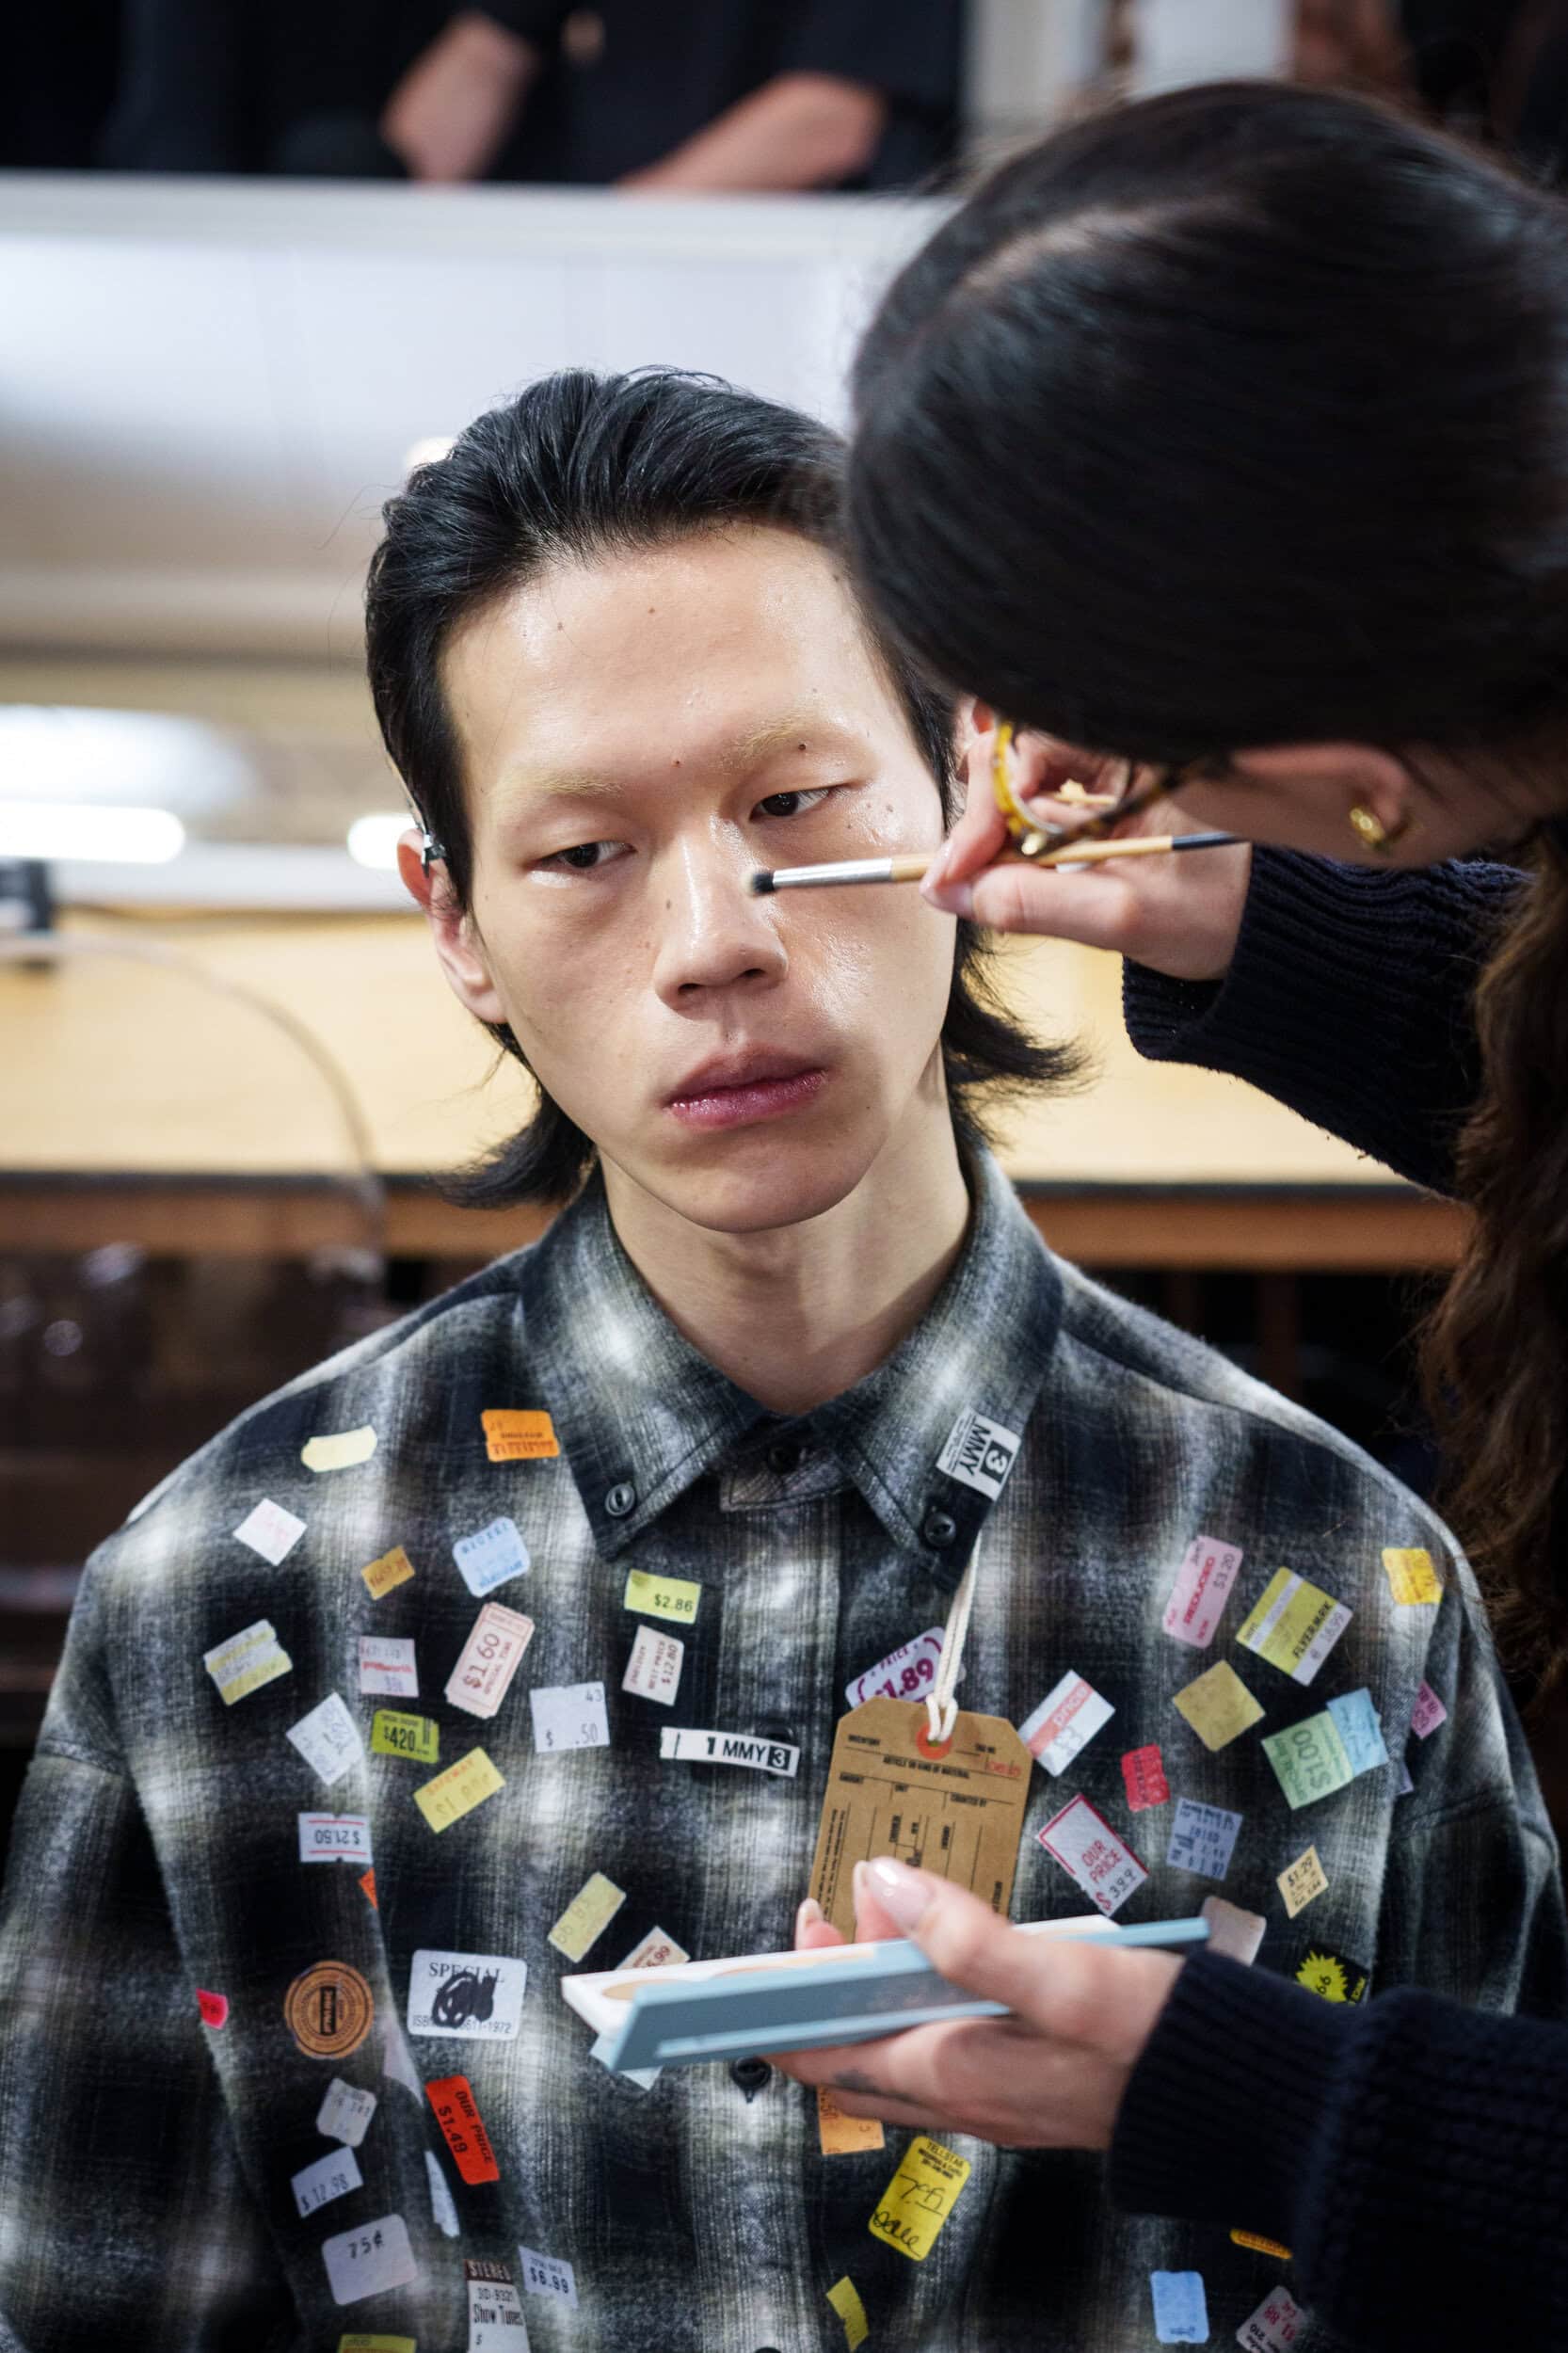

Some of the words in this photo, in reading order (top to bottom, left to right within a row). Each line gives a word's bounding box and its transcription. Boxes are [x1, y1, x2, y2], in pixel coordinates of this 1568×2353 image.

[960, 1423, 992, 1477] MMY
[653, 1593, 695, 1614] $2.86
[462, 1631, 503, 1691] $1.60
[873, 1657, 936, 1700] 1.89
[722, 1740, 768, 1767] MMY
[313, 1828, 361, 1847] $21.50
[438, 2105, 469, 2153] $1.49
[455, 2089, 477, 2121] OUR
[470, 2123, 495, 2165] PRICE
